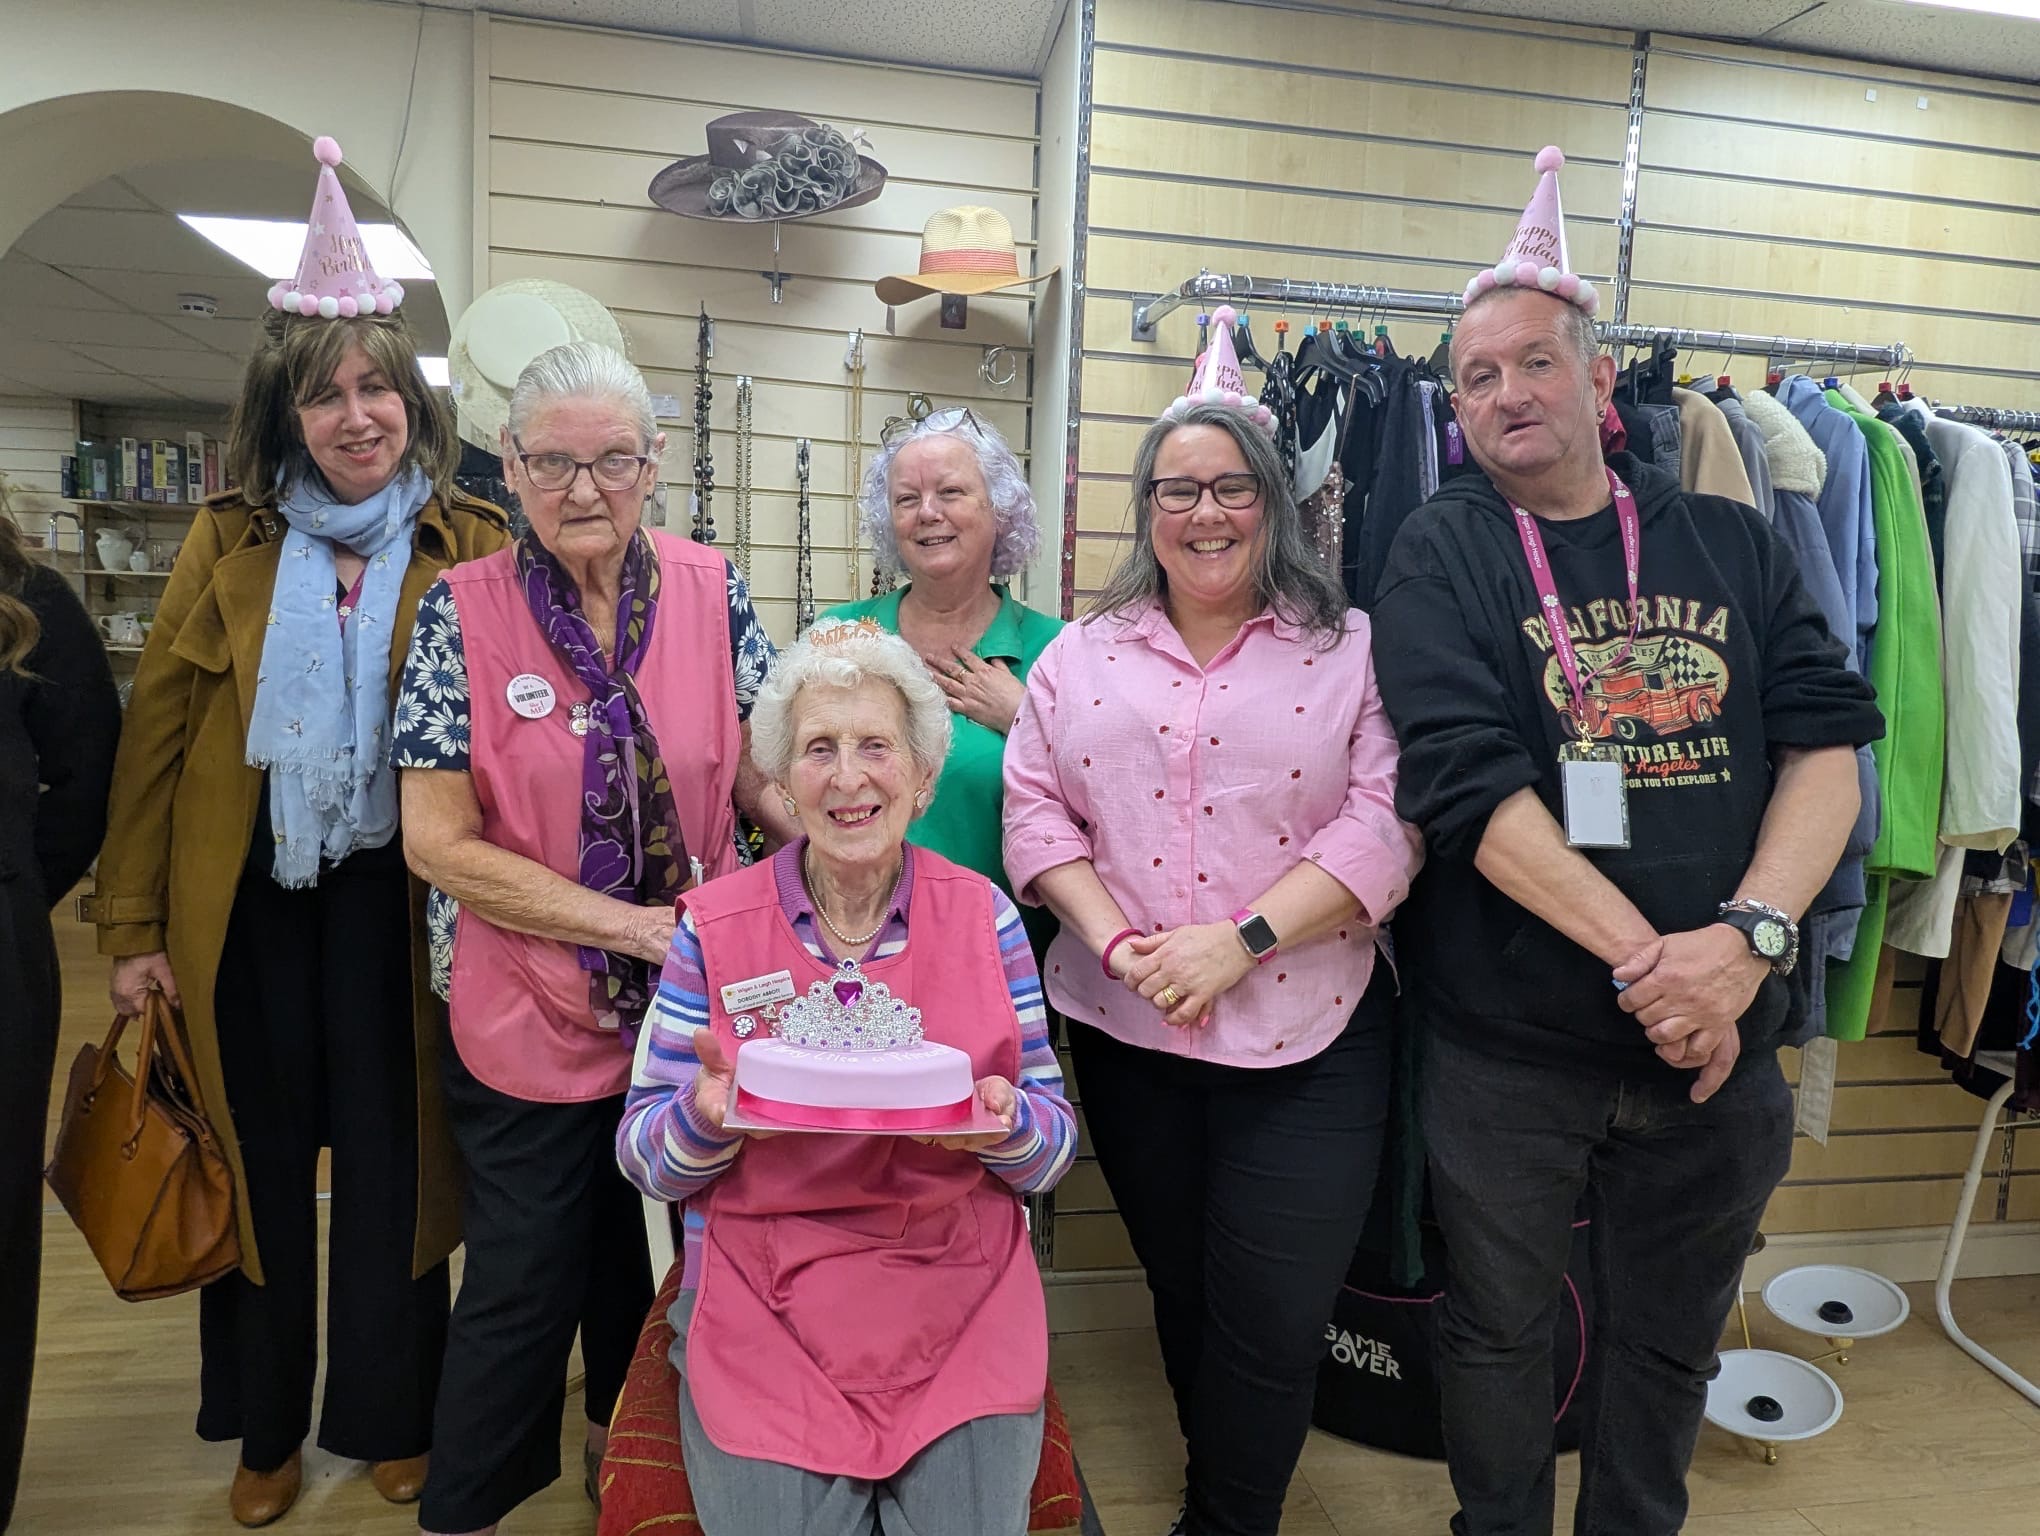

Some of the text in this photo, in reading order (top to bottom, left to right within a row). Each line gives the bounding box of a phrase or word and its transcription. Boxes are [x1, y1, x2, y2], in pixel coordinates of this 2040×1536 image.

[1531, 548, 1543, 569] Hospice
[514, 689, 550, 703] VOLUNTEER
[1686, 737, 1730, 760] LIFE
[1636, 754, 1701, 778] Angeles
[1644, 778, 1661, 788] YOU
[1664, 777, 1676, 787] TO
[1677, 773, 1717, 786] EXPLORE
[758, 980, 772, 989] Leigh
[1324, 1322, 1402, 1380] GAME OVER
